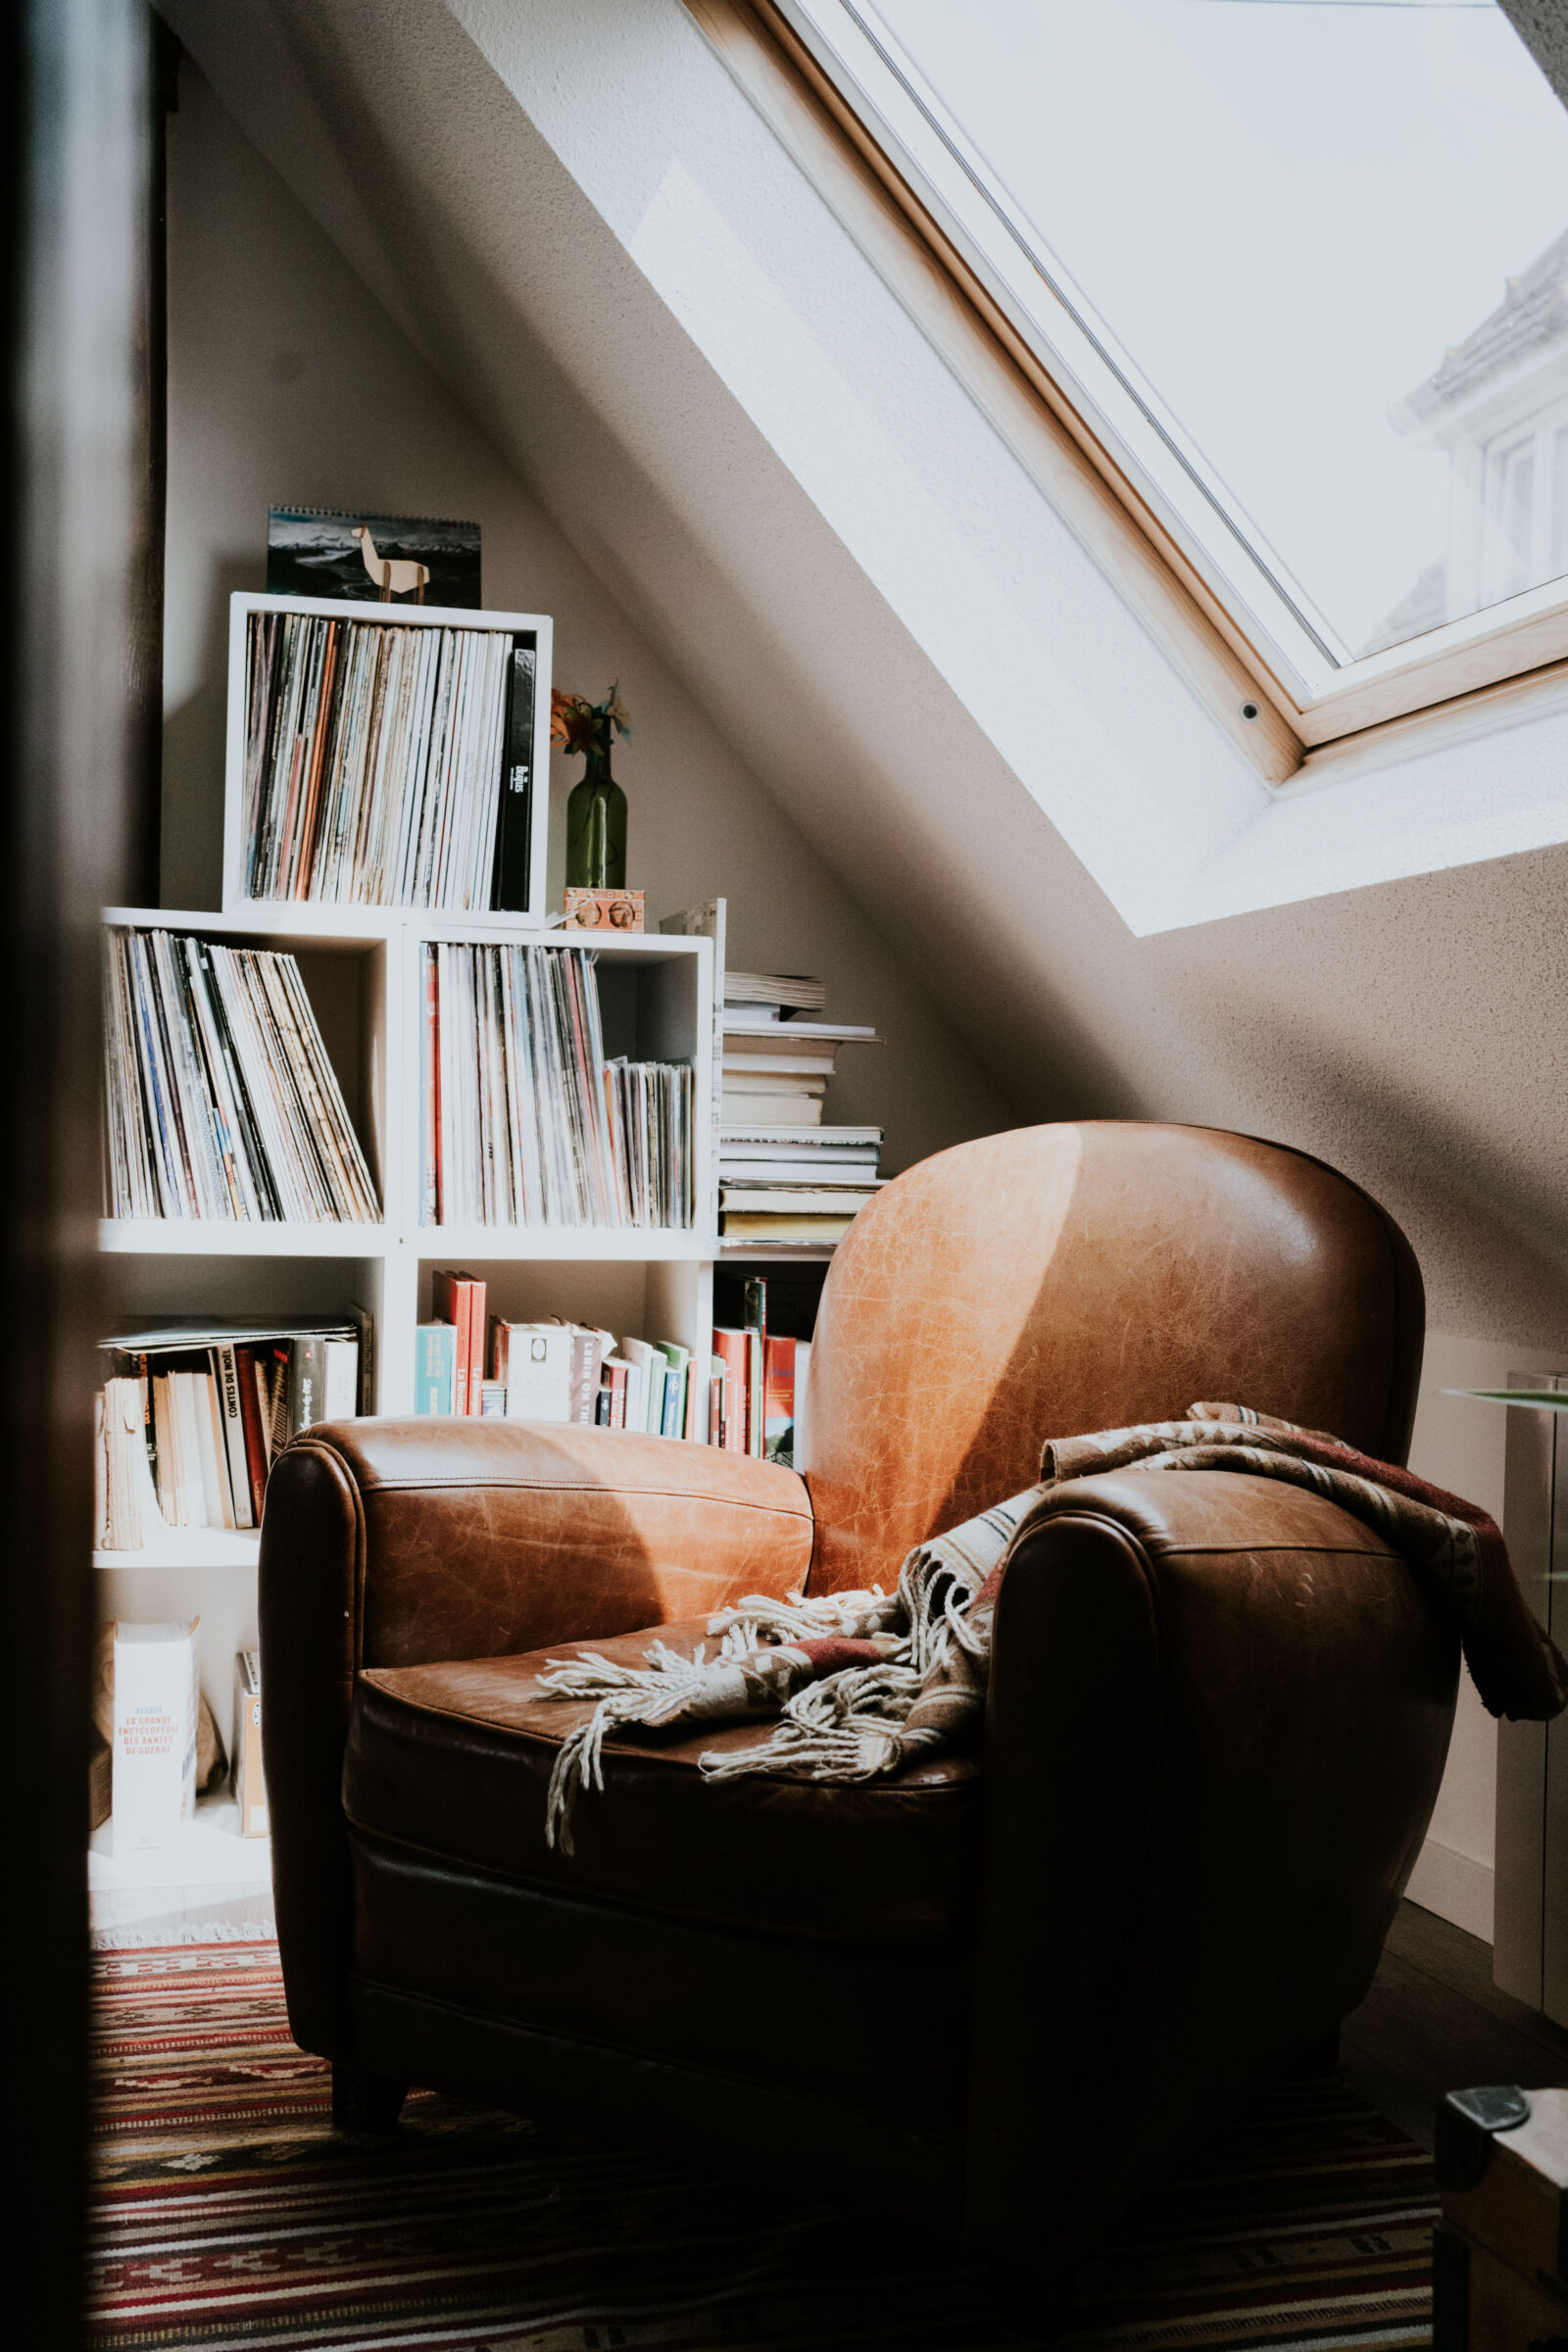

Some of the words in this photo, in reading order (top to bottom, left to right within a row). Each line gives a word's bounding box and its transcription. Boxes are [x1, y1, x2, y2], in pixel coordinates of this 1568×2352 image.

[222, 1348, 233, 1371] NOËL
[583, 1342, 594, 1379] LENIN
[225, 1373, 234, 1384] DE
[581, 1383, 591, 1400] ON
[227, 1386, 238, 1418] CONTES
[138, 1716, 172, 1725] GRANDE
[123, 1737, 140, 1745] DES
[125, 1746, 136, 1755] DE
[138, 1745, 171, 1755] GUERRE
